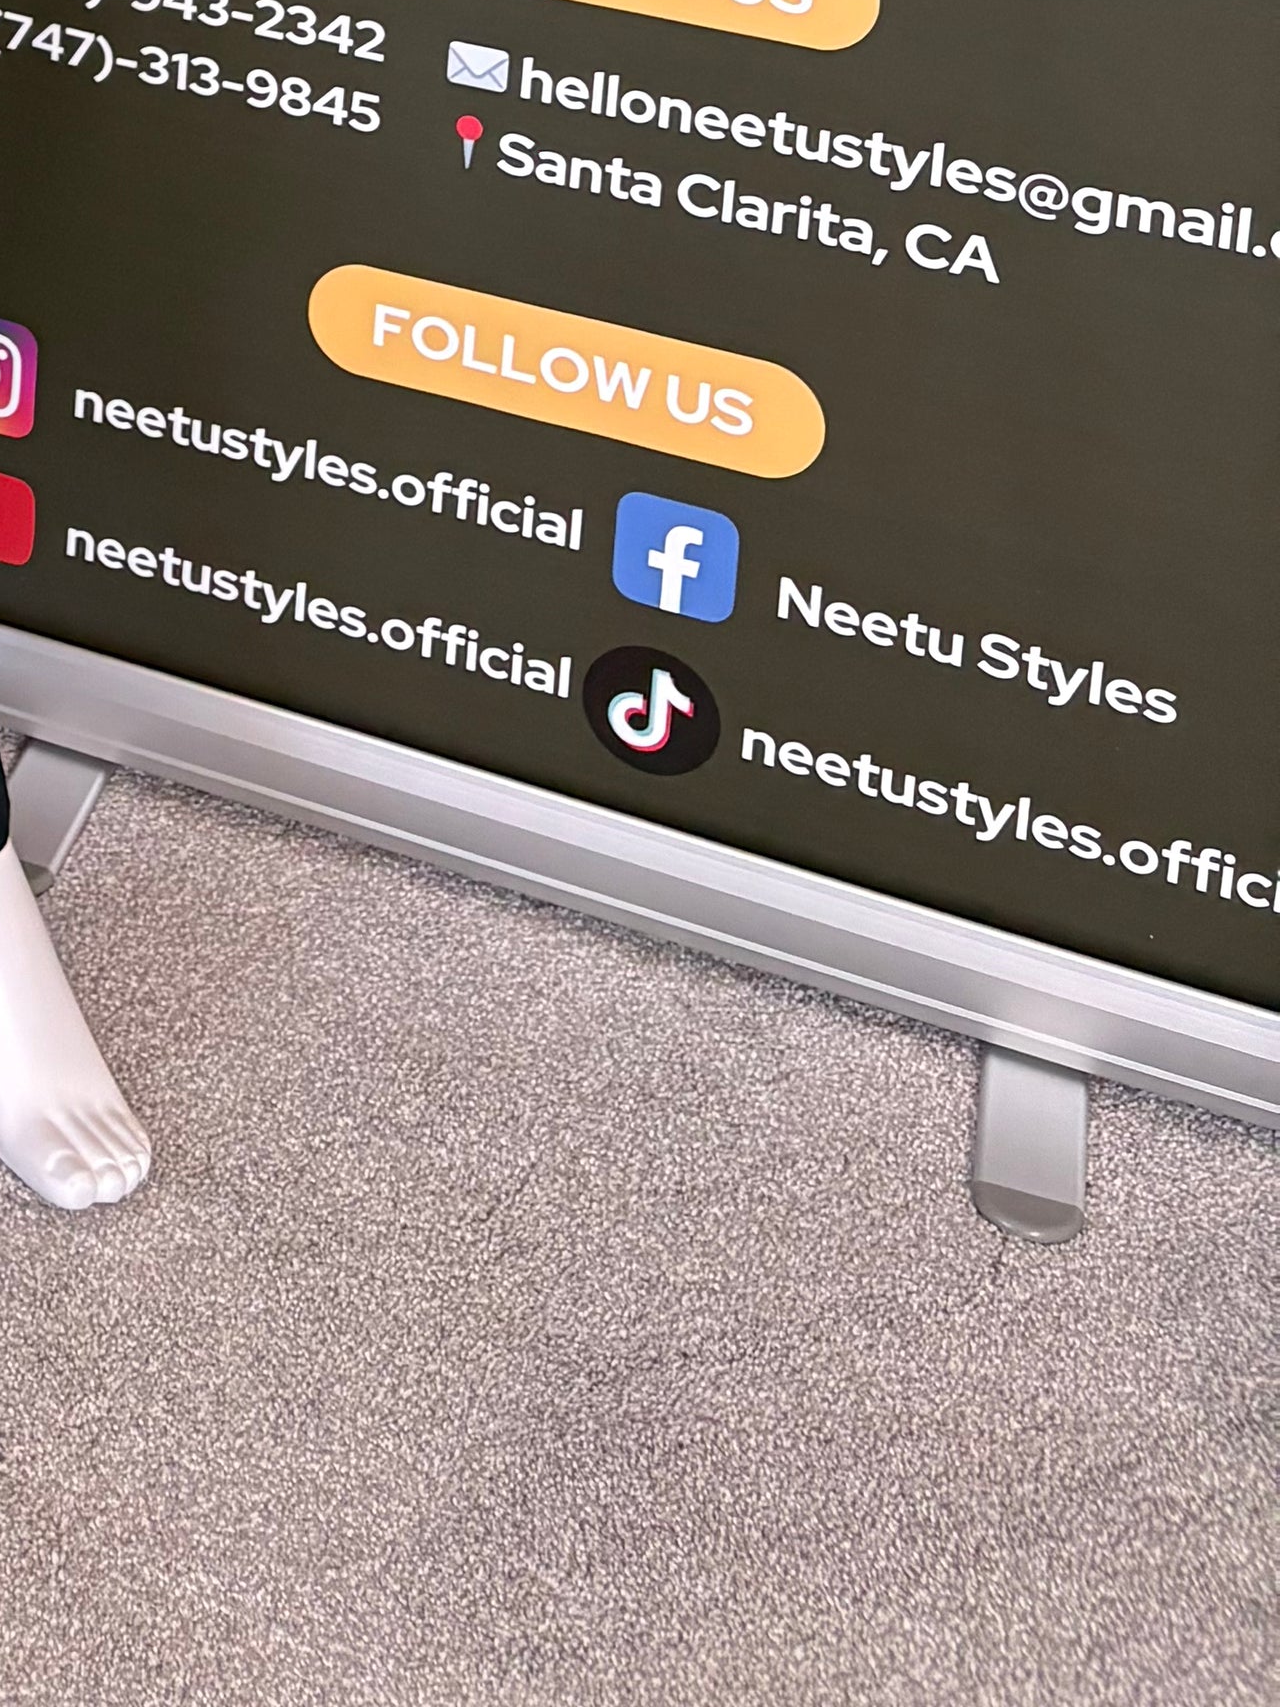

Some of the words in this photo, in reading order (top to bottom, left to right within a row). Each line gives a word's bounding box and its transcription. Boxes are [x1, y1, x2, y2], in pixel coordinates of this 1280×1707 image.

[497, 134, 662, 206] Santa
[678, 174, 888, 265] Clarita,
[906, 224, 999, 283] CA
[520, 57, 1280, 258] helloneetustyles@gmail.
[372, 303, 652, 410] FOLLOW
[666, 374, 753, 436] US
[75, 390, 582, 550] neetustyles.official
[67, 528, 571, 698] neetustyles.official
[778, 577, 963, 667] Neetu
[977, 634, 1177, 723] Styles
